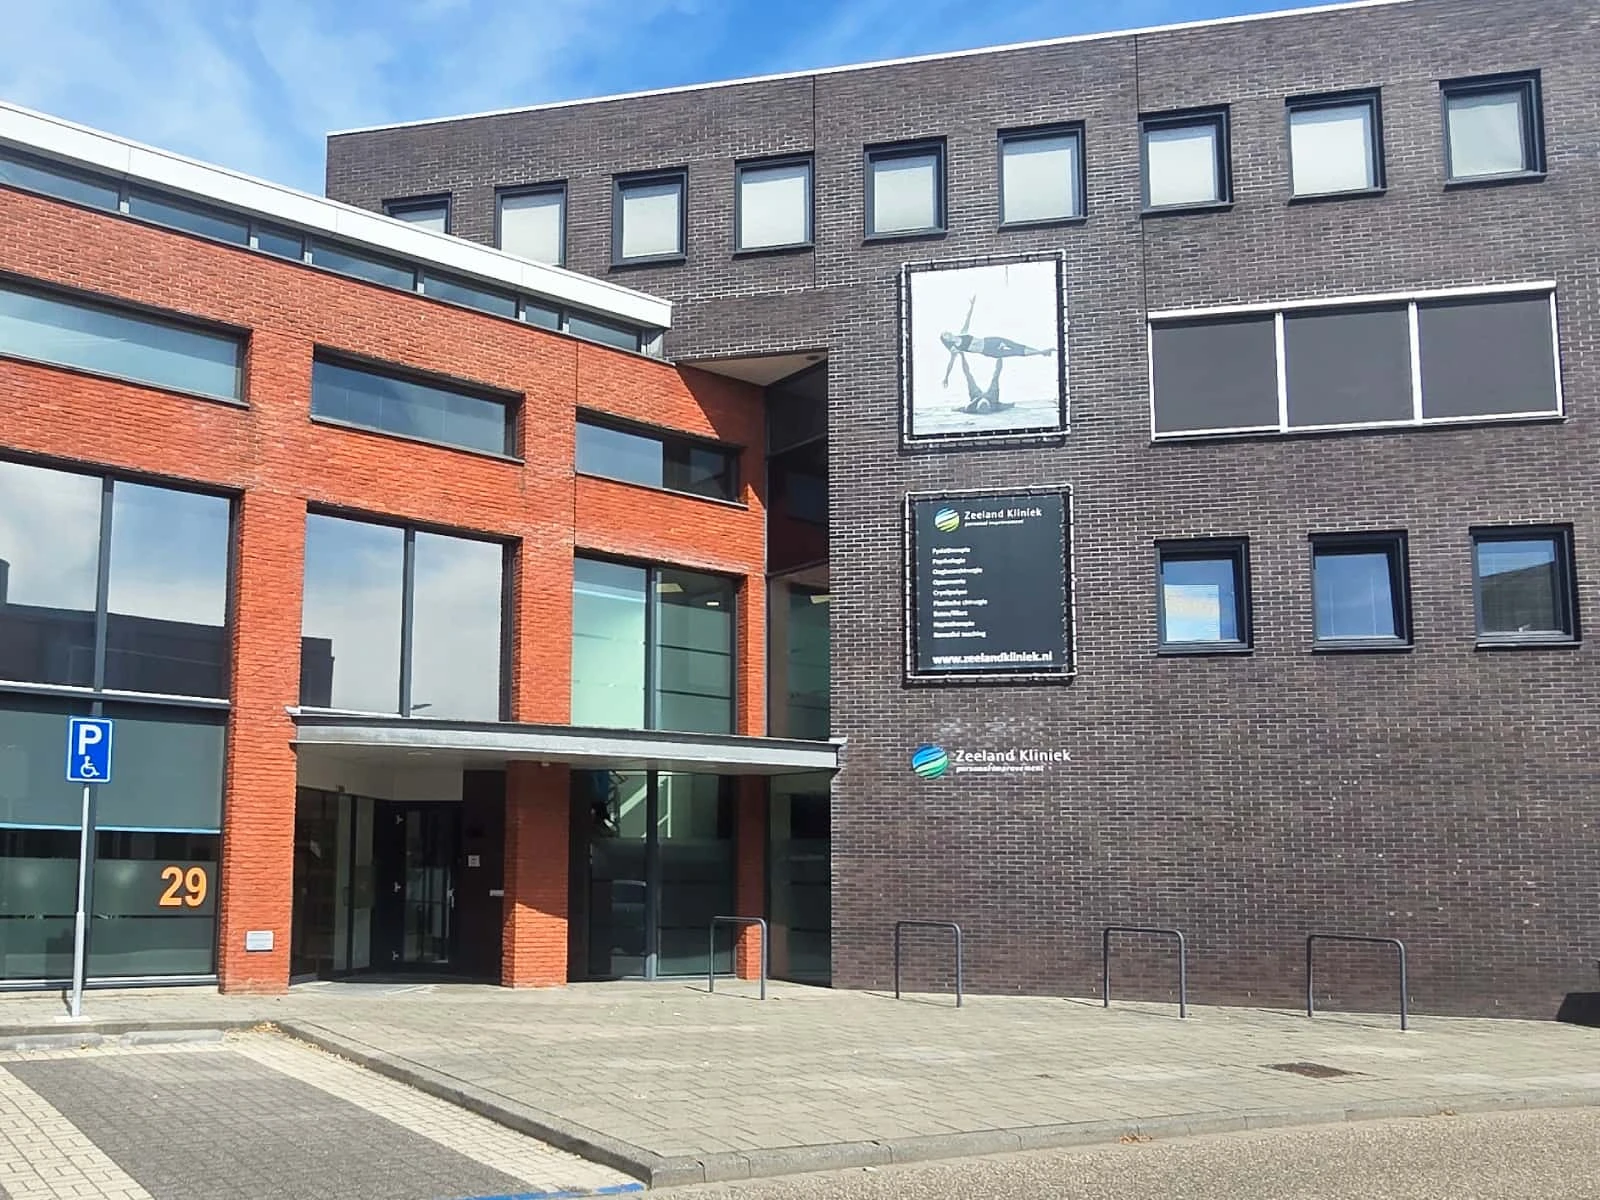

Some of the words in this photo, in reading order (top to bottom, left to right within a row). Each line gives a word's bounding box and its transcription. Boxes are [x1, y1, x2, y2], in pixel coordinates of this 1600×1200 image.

[964, 509, 1004, 520] Zeeland
[1007, 507, 1043, 518] Kliniek
[932, 650, 1053, 664] www.zeelandkliniek.nl
[78, 724, 102, 755] P
[955, 749, 1016, 761] Zeeland
[1019, 748, 1072, 761] Kliniek
[159, 866, 208, 906] 29
